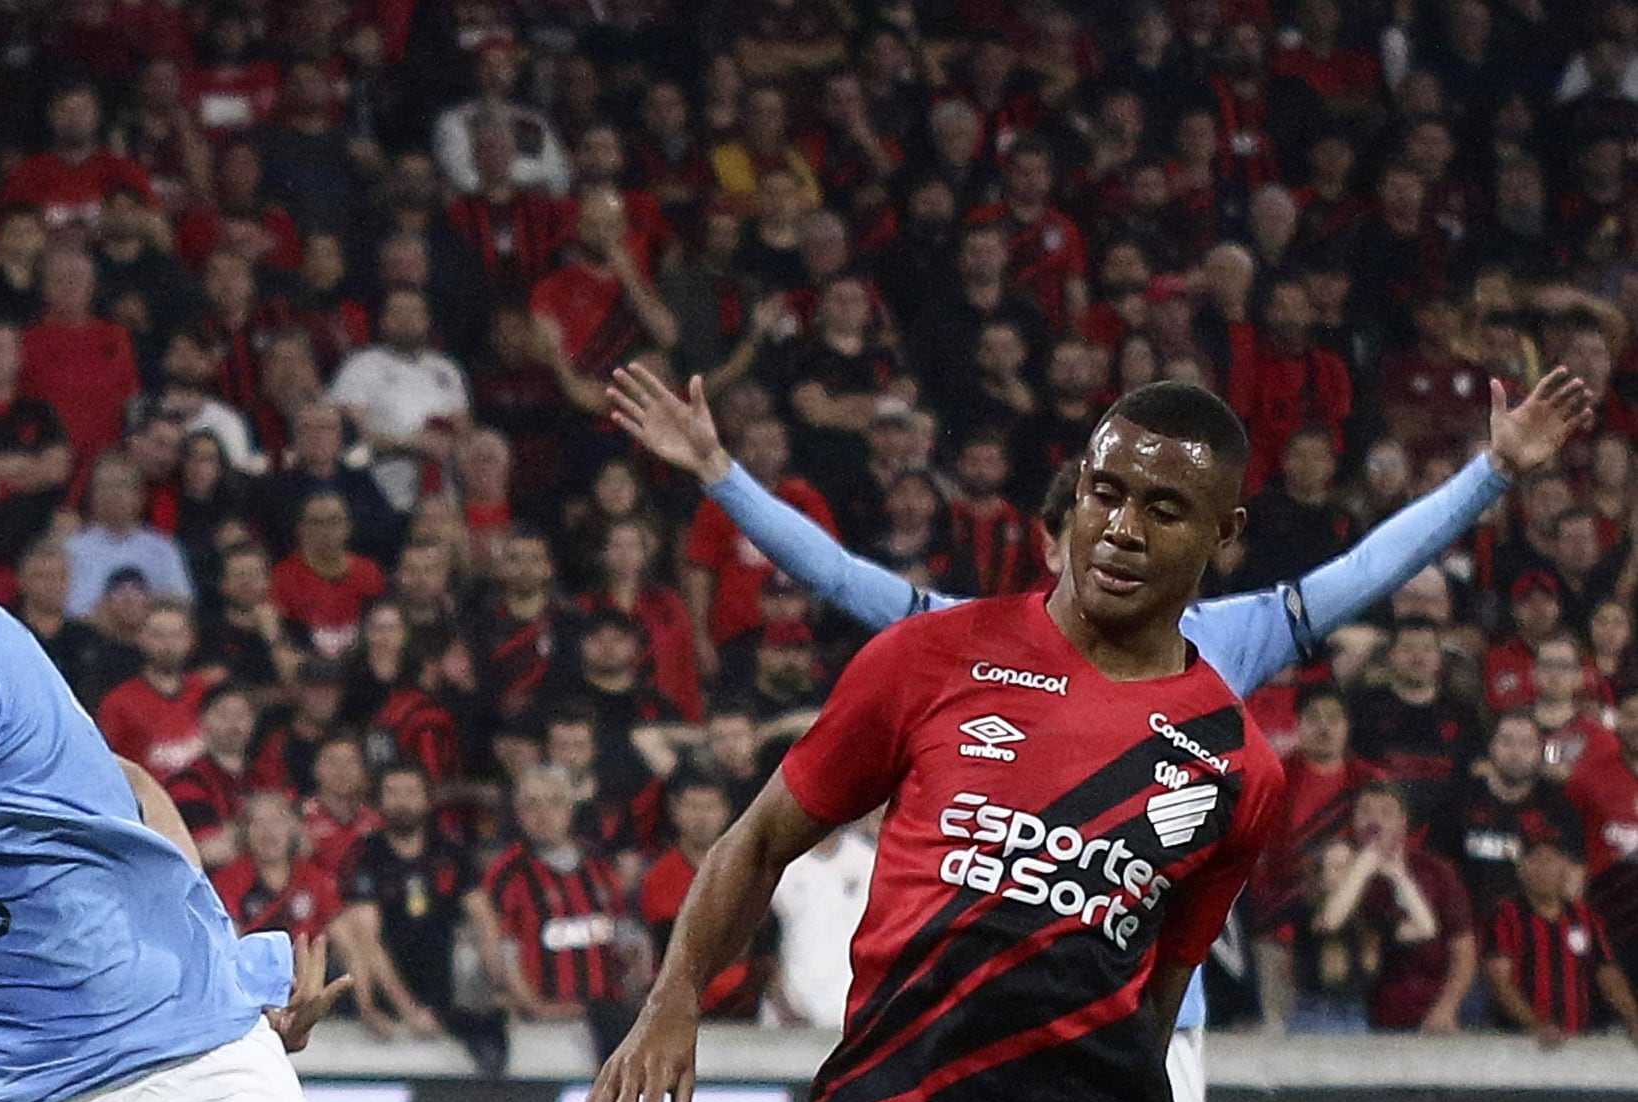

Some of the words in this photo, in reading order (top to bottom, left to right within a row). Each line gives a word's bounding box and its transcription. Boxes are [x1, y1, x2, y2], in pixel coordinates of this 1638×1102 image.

[970, 661, 1069, 696] Copacol
[959, 743, 1016, 762] umbro
[1148, 712, 1230, 776] Copacol
[939, 792, 1172, 911] Esportes
[939, 844, 1140, 951] daSorte
